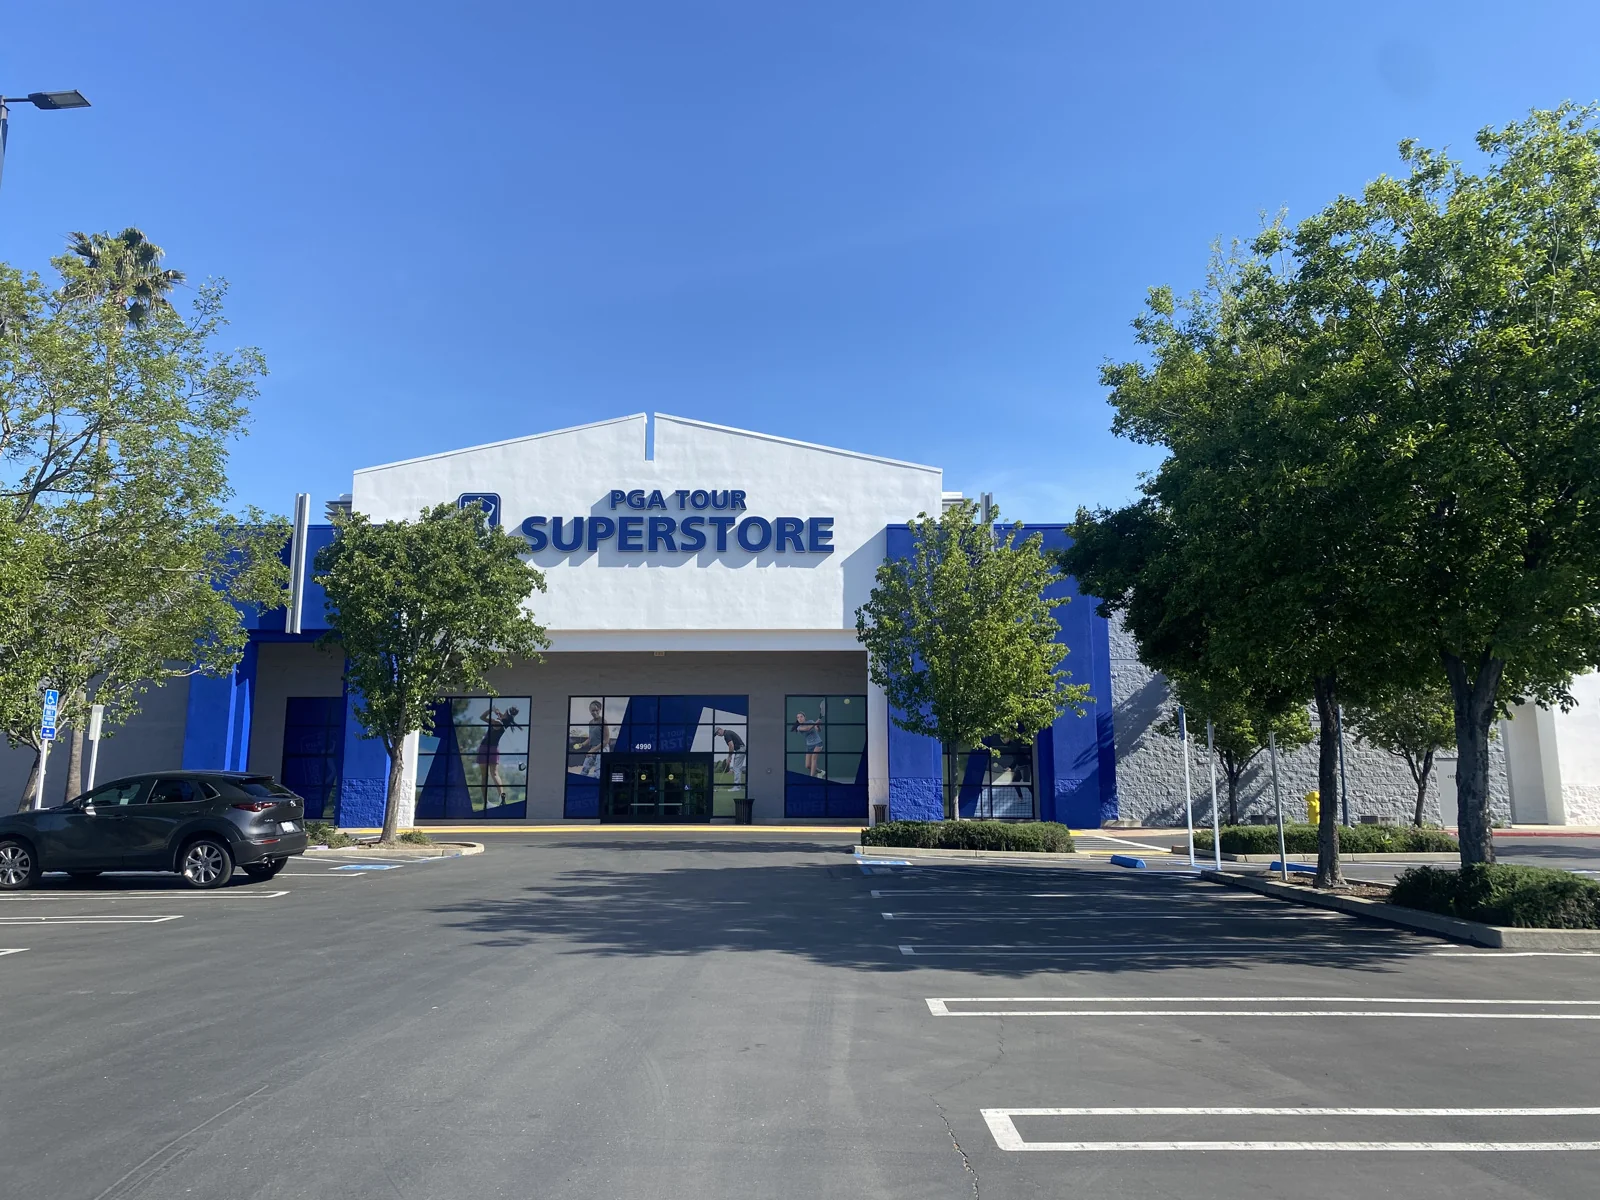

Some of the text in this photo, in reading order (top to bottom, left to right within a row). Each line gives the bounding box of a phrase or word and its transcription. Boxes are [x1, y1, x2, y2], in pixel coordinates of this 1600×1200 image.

[610, 490, 746, 510] PGA TOUR
[521, 516, 834, 553] SUPERSTORE
